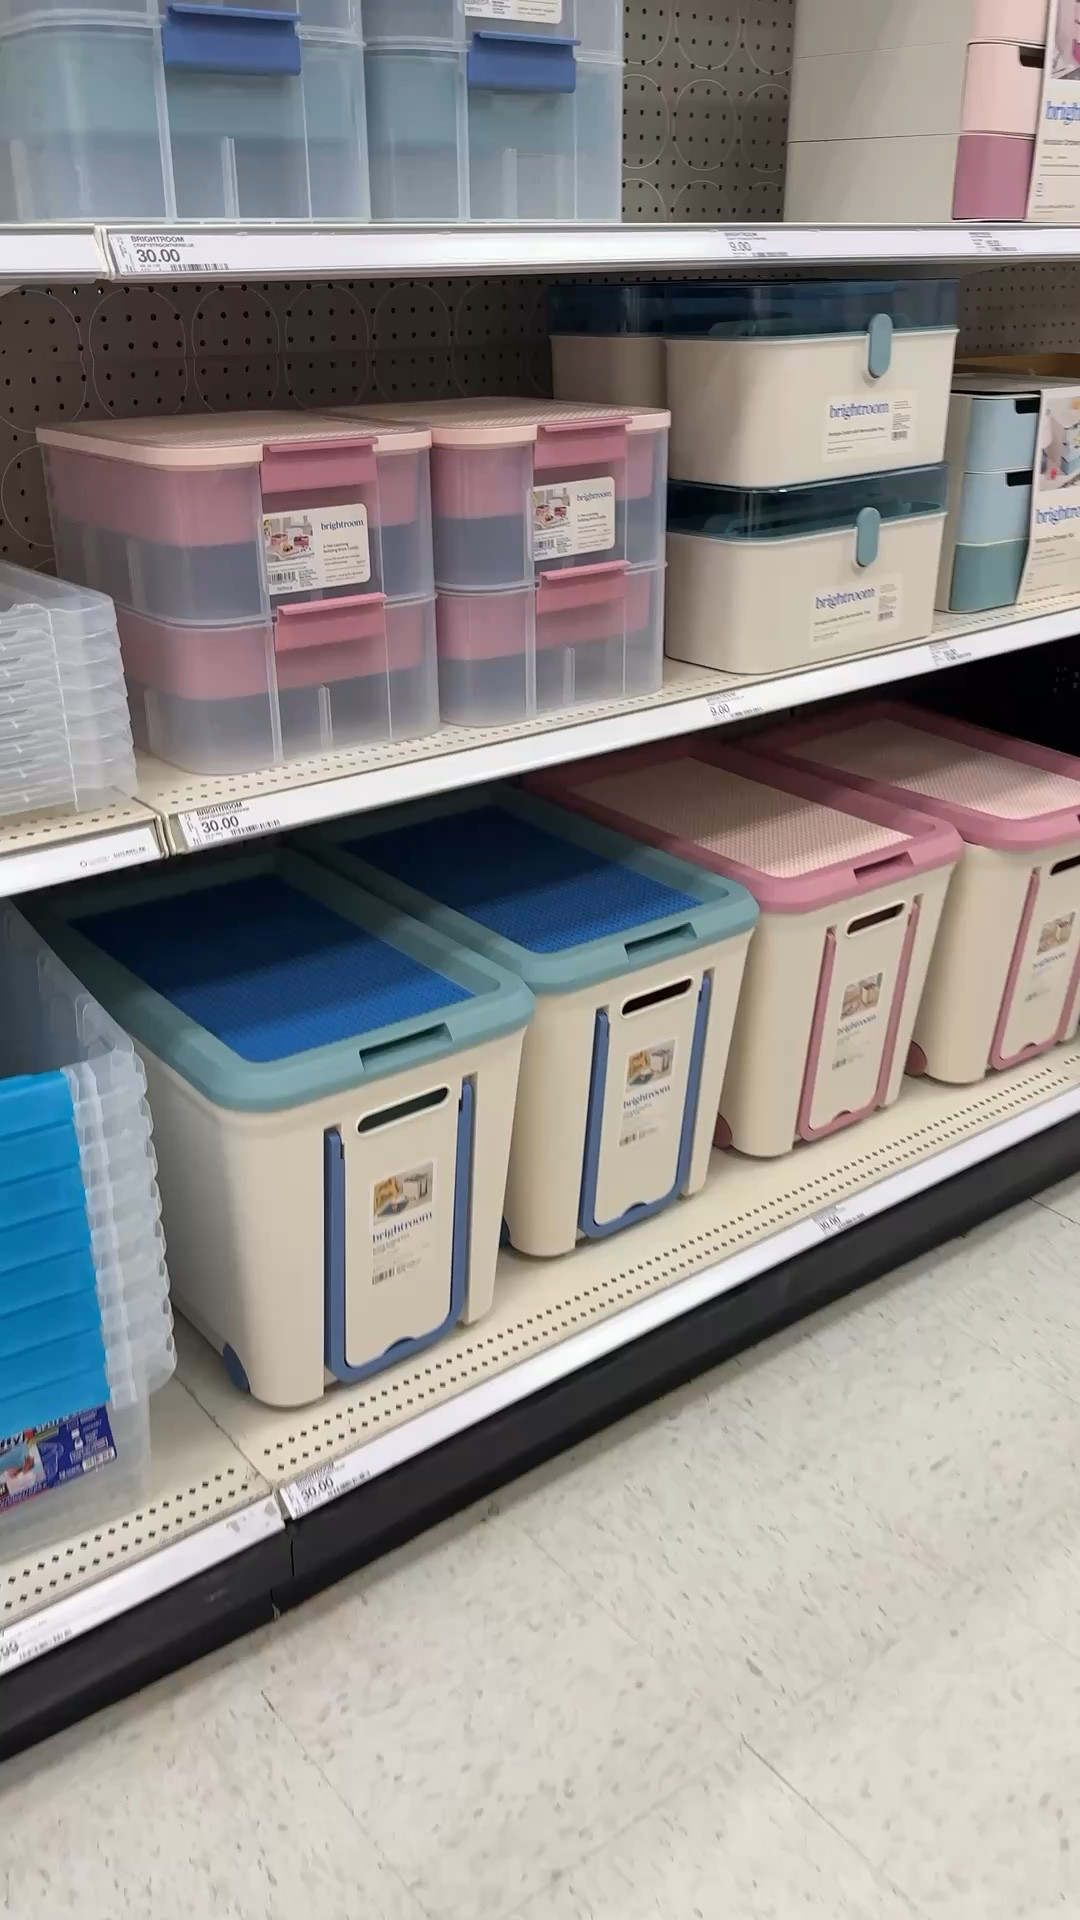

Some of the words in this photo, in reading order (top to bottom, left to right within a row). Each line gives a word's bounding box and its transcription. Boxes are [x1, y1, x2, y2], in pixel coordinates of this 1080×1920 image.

[729, 241, 752, 252] 9.00
[136, 249, 181, 263] 30.00
[829, 402, 889, 420] brightroom
[320, 519, 365, 531] brightroom
[710, 703, 730, 717] 9.00
[201, 815, 239, 834] 30.00
[301, 1475, 335, 1504] 30.00
